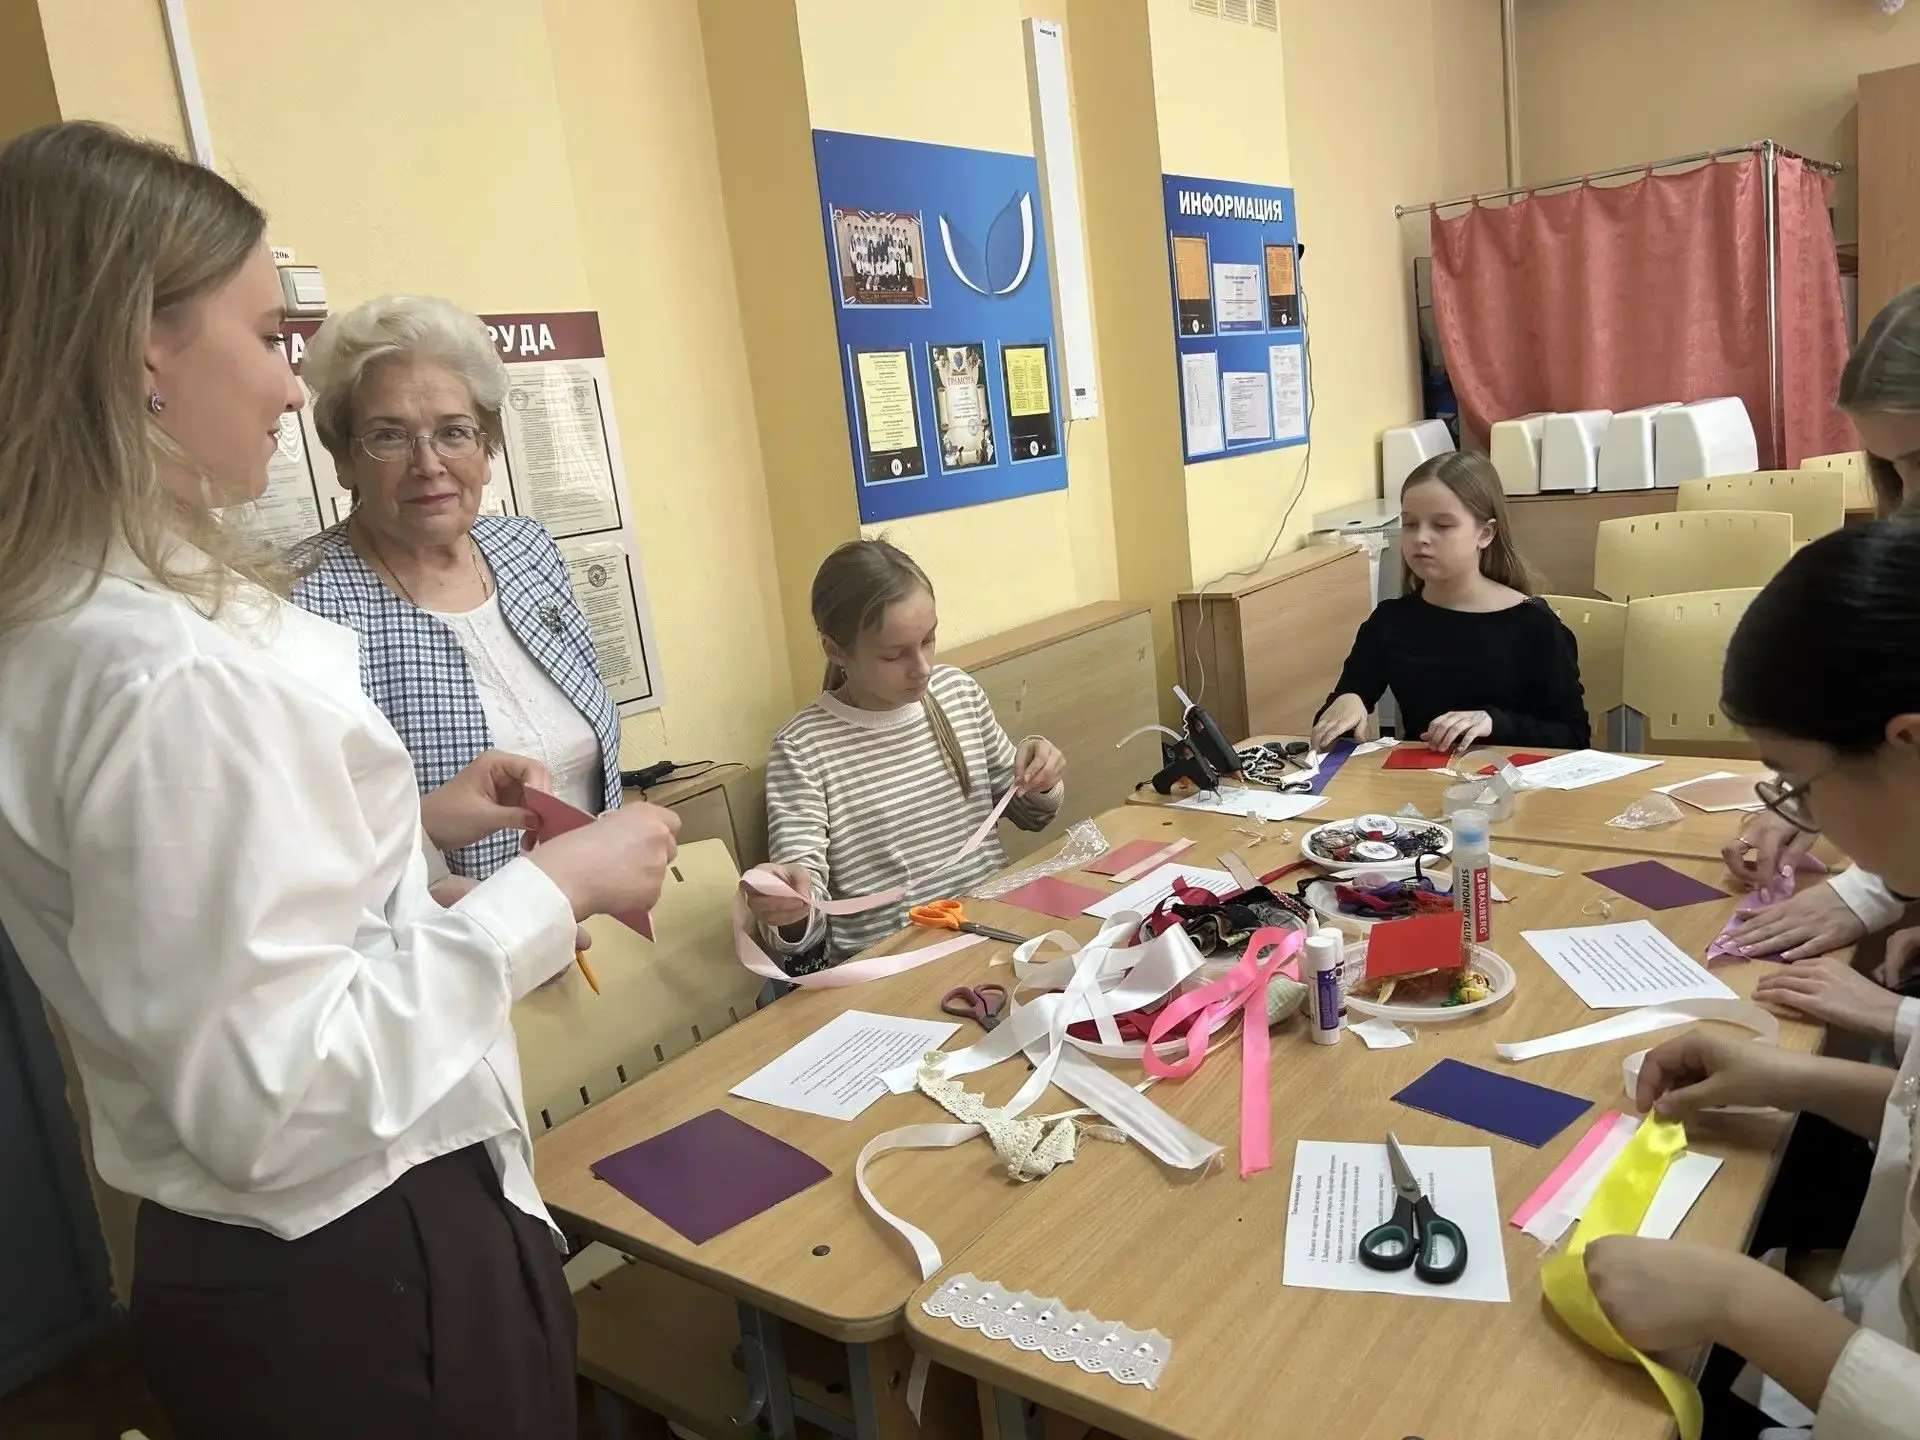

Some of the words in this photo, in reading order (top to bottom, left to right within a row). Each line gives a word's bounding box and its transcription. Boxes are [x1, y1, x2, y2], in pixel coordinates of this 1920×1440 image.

[1179, 190, 1283, 223] ИНФОРМАЦИЯ
[1461, 869, 1472, 922] STATIONERY
[1478, 884, 1488, 934] BRAUBERG
